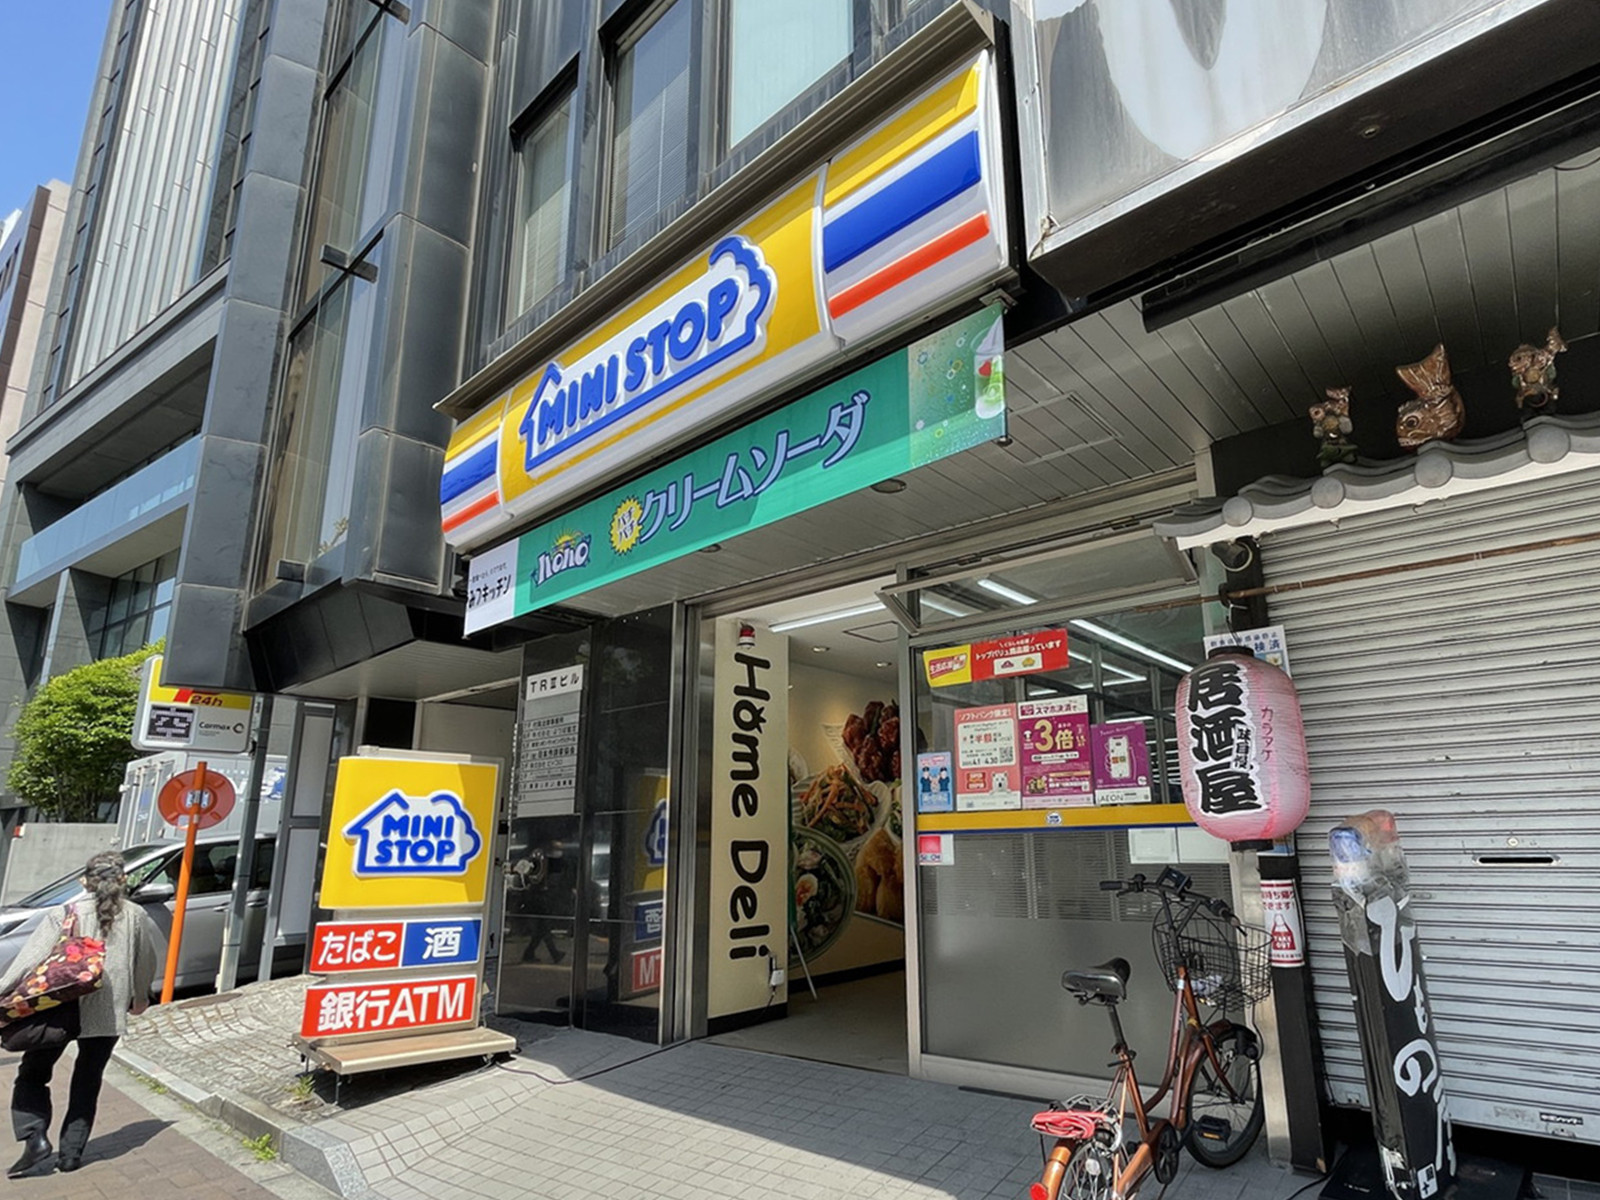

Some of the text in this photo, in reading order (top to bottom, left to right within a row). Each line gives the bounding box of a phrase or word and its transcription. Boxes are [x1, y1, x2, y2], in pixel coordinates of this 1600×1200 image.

[538, 278, 741, 445] MINI STOP
[639, 390, 871, 545] クリームソーダ
[190, 695, 223, 707] 24h
[729, 652, 771, 819] Home
[1034, 719, 1054, 752] 3
[1055, 729, 1074, 750] 倍
[1188, 663, 1262, 815] 居酒屋
[381, 814, 455, 839] MINI
[375, 840, 456, 864] STOP
[729, 840, 771, 960] Deli
[318, 928, 397, 966] たばこ
[422, 926, 463, 960] 酒
[316, 982, 466, 1033] 銀行ATM
